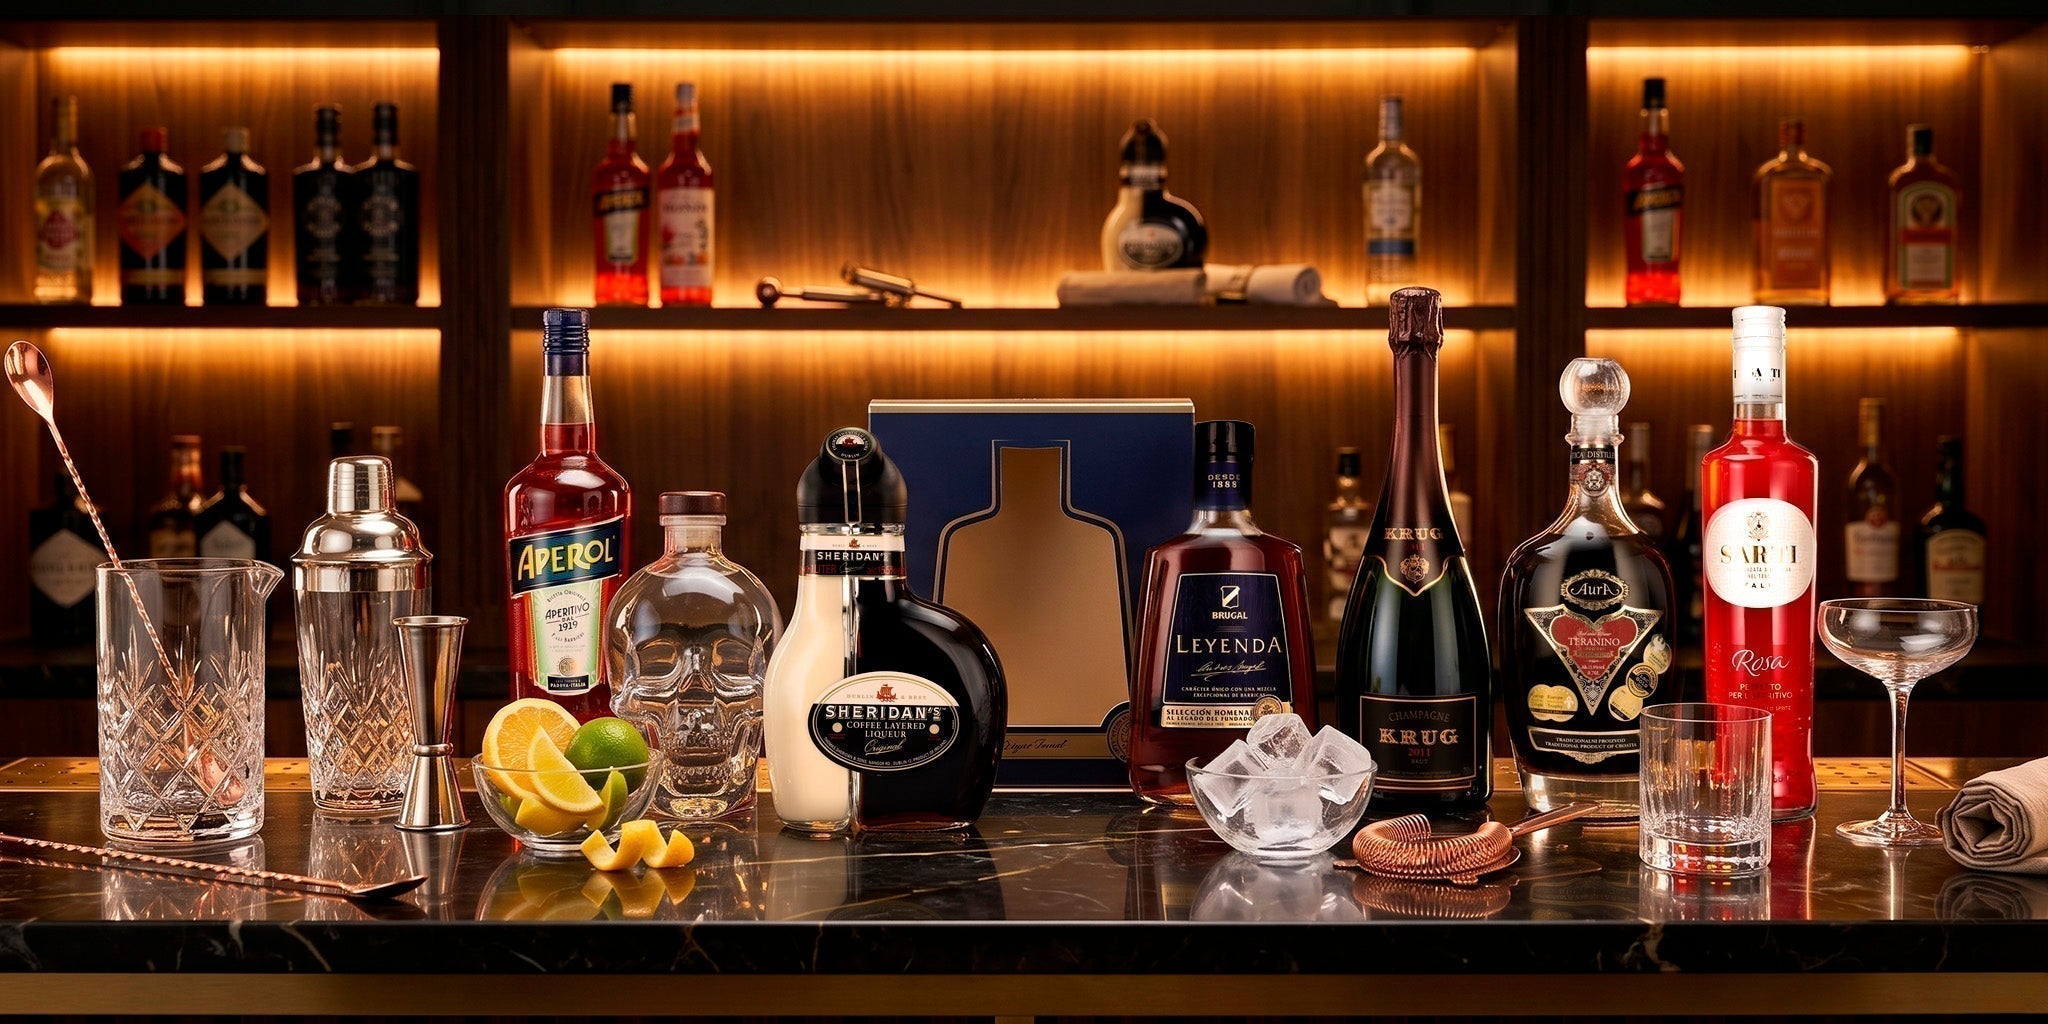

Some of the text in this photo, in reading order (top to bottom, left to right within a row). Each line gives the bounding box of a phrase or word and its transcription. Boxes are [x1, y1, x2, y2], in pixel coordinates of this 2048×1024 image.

[1384, 527, 1444, 540] KRUG
[518, 538, 614, 582] APEROL
[817, 552, 888, 562] SHERIDAN'S
[1720, 545, 1796, 564] SARI
[545, 602, 590, 620] APERITIVO
[1212, 611, 1248, 620] BRUGAL
[558, 620, 578, 632] 1919
[1176, 634, 1282, 654] LEYENDA
[1568, 636, 1620, 646] TERANINO
[1732, 649, 1790, 676] Rosa
[825, 705, 942, 721] SHERIDAN'S
[1388, 710, 1450, 722] CHAMPAGNE
[846, 720, 926, 730] COFFEE LAYERED
[865, 730, 906, 740] LIQUEUR
[1378, 728, 1459, 746] KRUG
